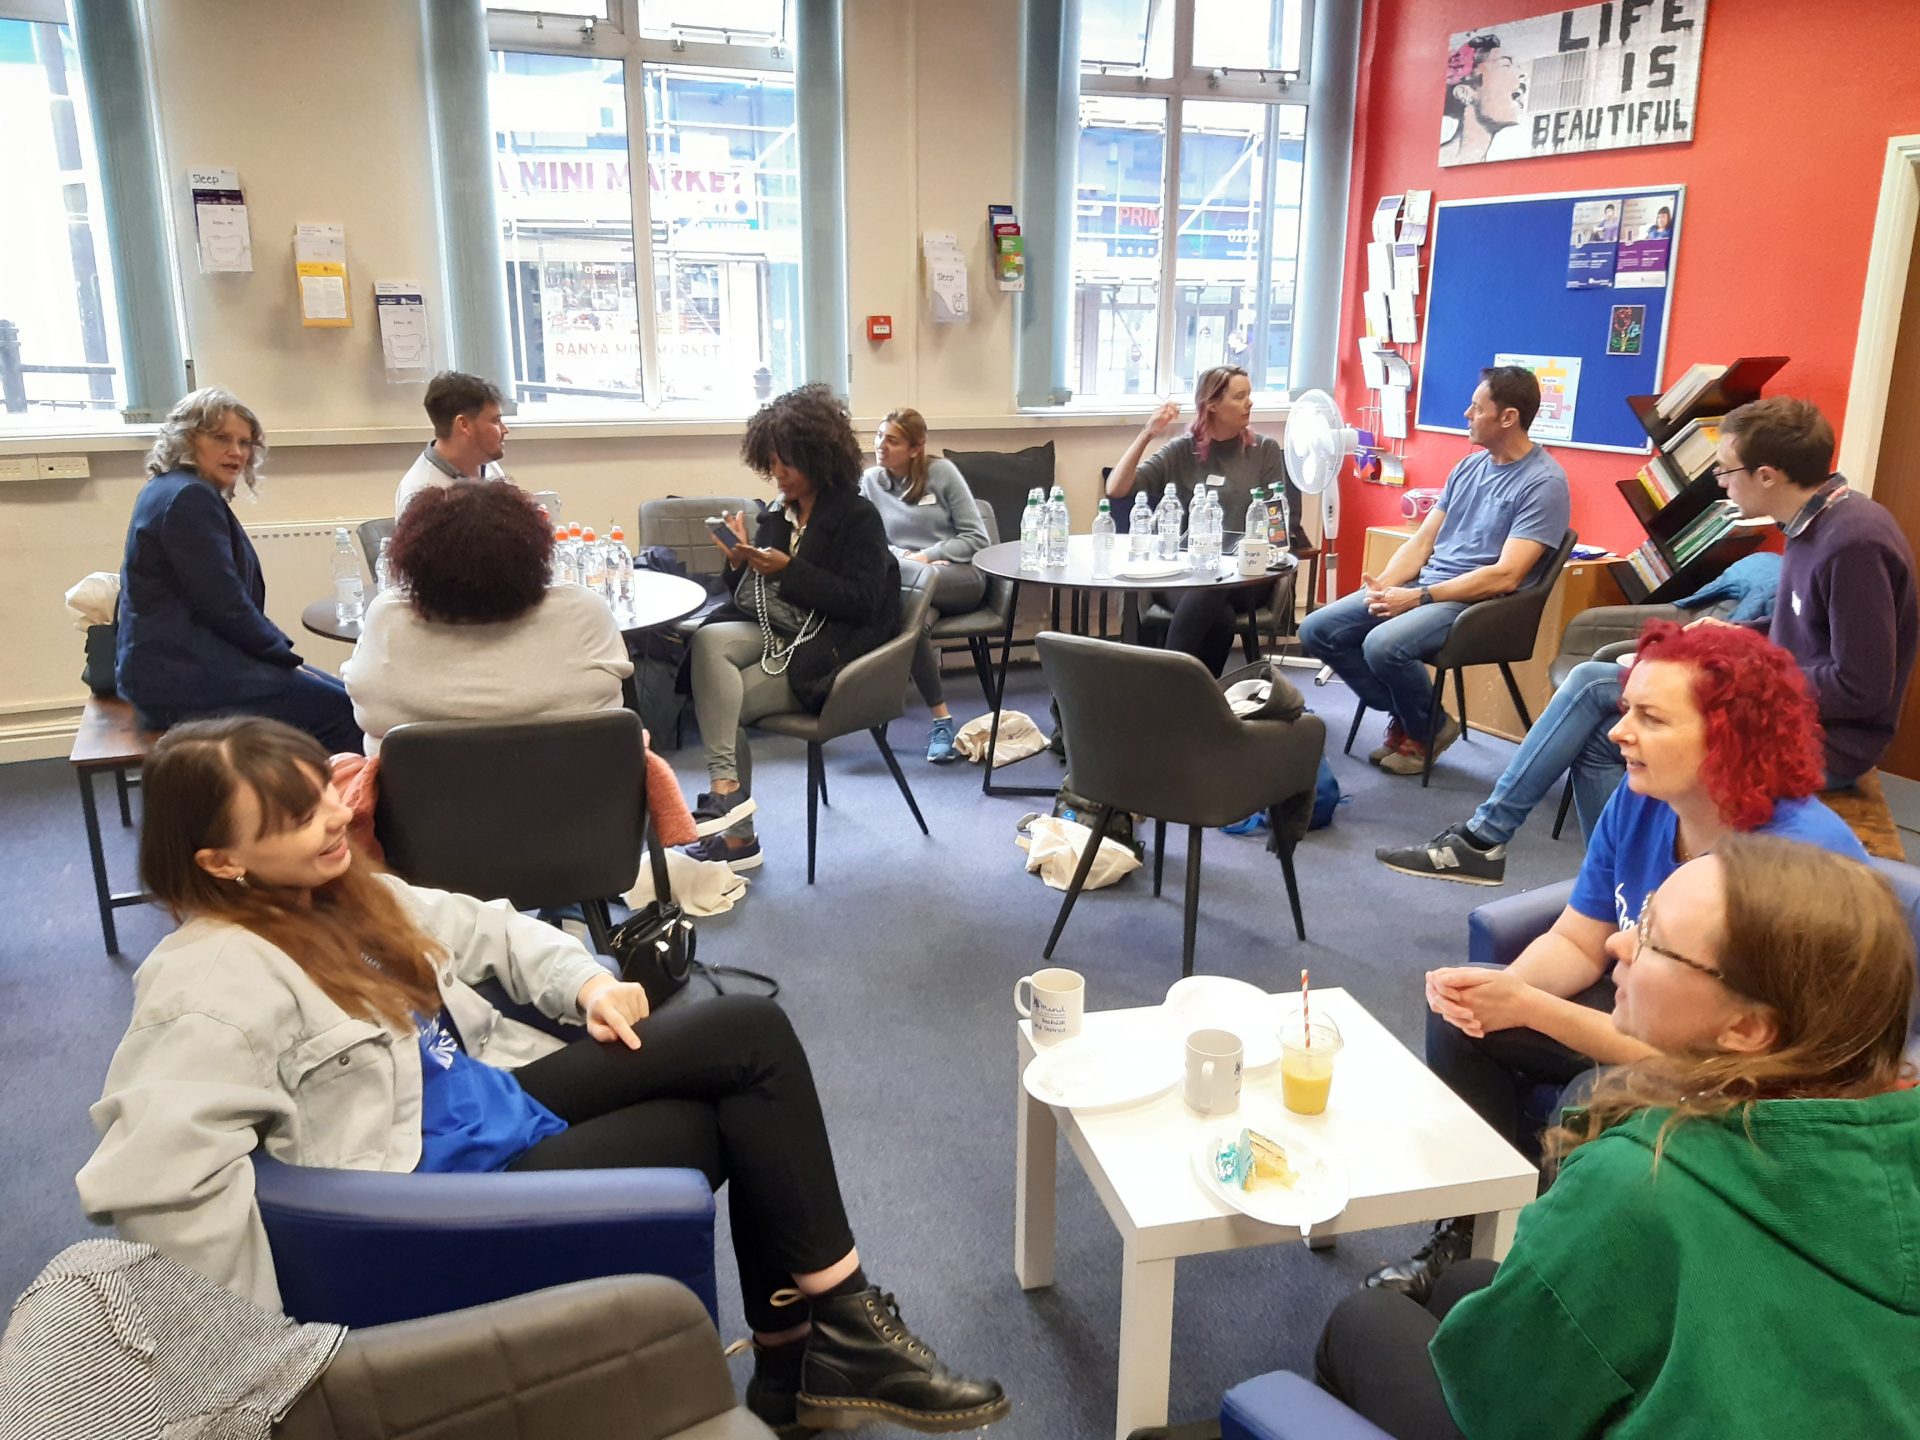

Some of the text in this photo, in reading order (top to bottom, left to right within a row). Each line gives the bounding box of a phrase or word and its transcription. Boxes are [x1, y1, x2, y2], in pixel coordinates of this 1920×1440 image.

[1558, 0, 1695, 52] LIFE
[1621, 45, 1678, 94] IS
[1531, 98, 1688, 148] BEAUTIFUL
[192, 173, 220, 186] Sleep
[518, 161, 594, 191] MINI
[555, 342, 609, 355] RANYA
